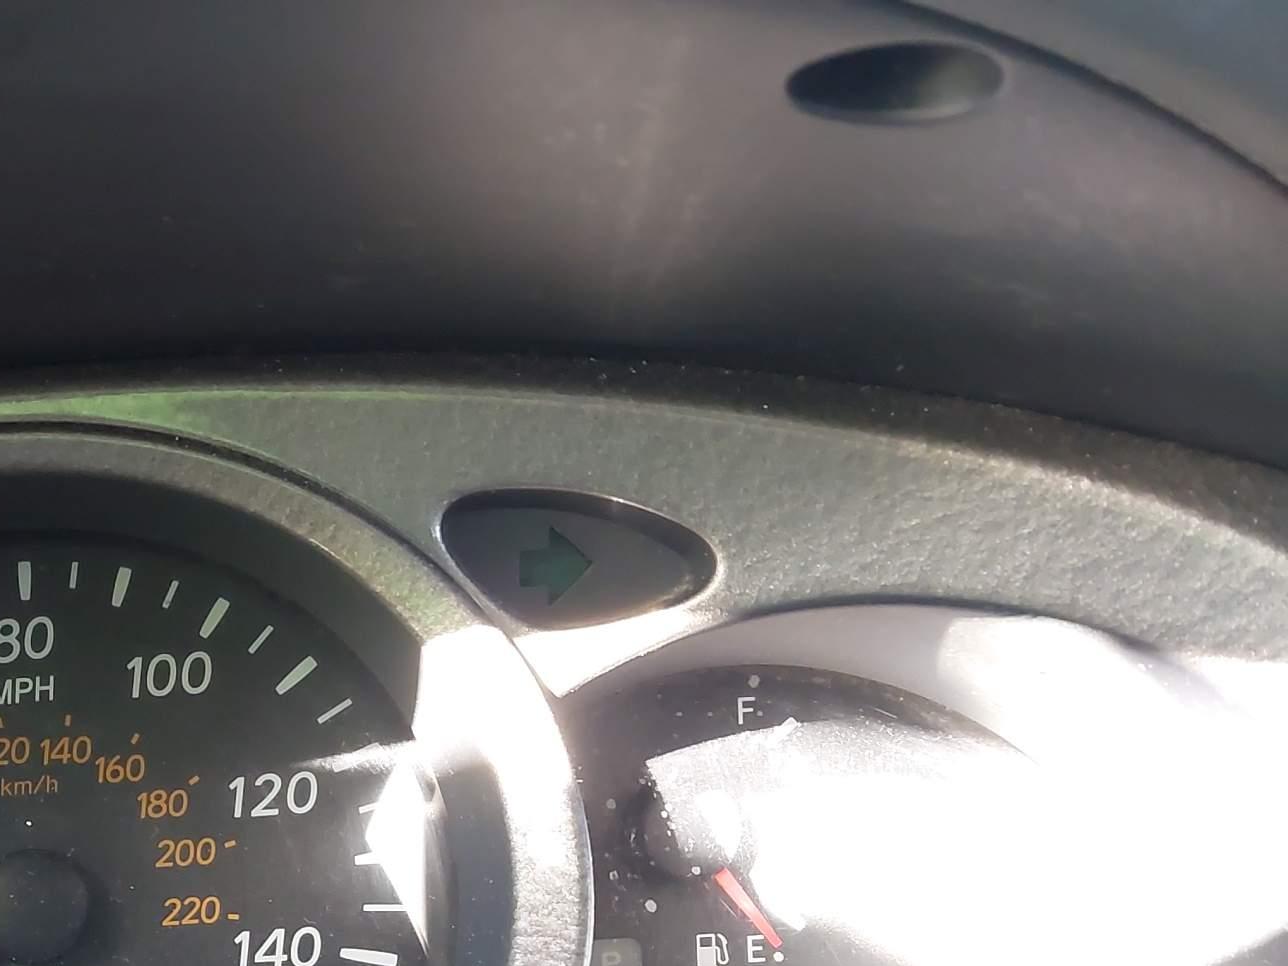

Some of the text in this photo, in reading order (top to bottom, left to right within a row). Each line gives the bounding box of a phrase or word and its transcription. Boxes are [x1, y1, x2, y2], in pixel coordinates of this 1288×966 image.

[127, 651, 212, 698] 100
[737, 697, 756, 725] F
[40, 736, 92, 766] 140
[95, 754, 146, 784] 160
[1, 775, 59, 798] km/h
[228, 771, 318, 818] 120
[137, 790, 189, 819] 180
[155, 838, 216, 868] 200
[162, 896, 221, 926] 220
[746, 934, 766, 963] E
